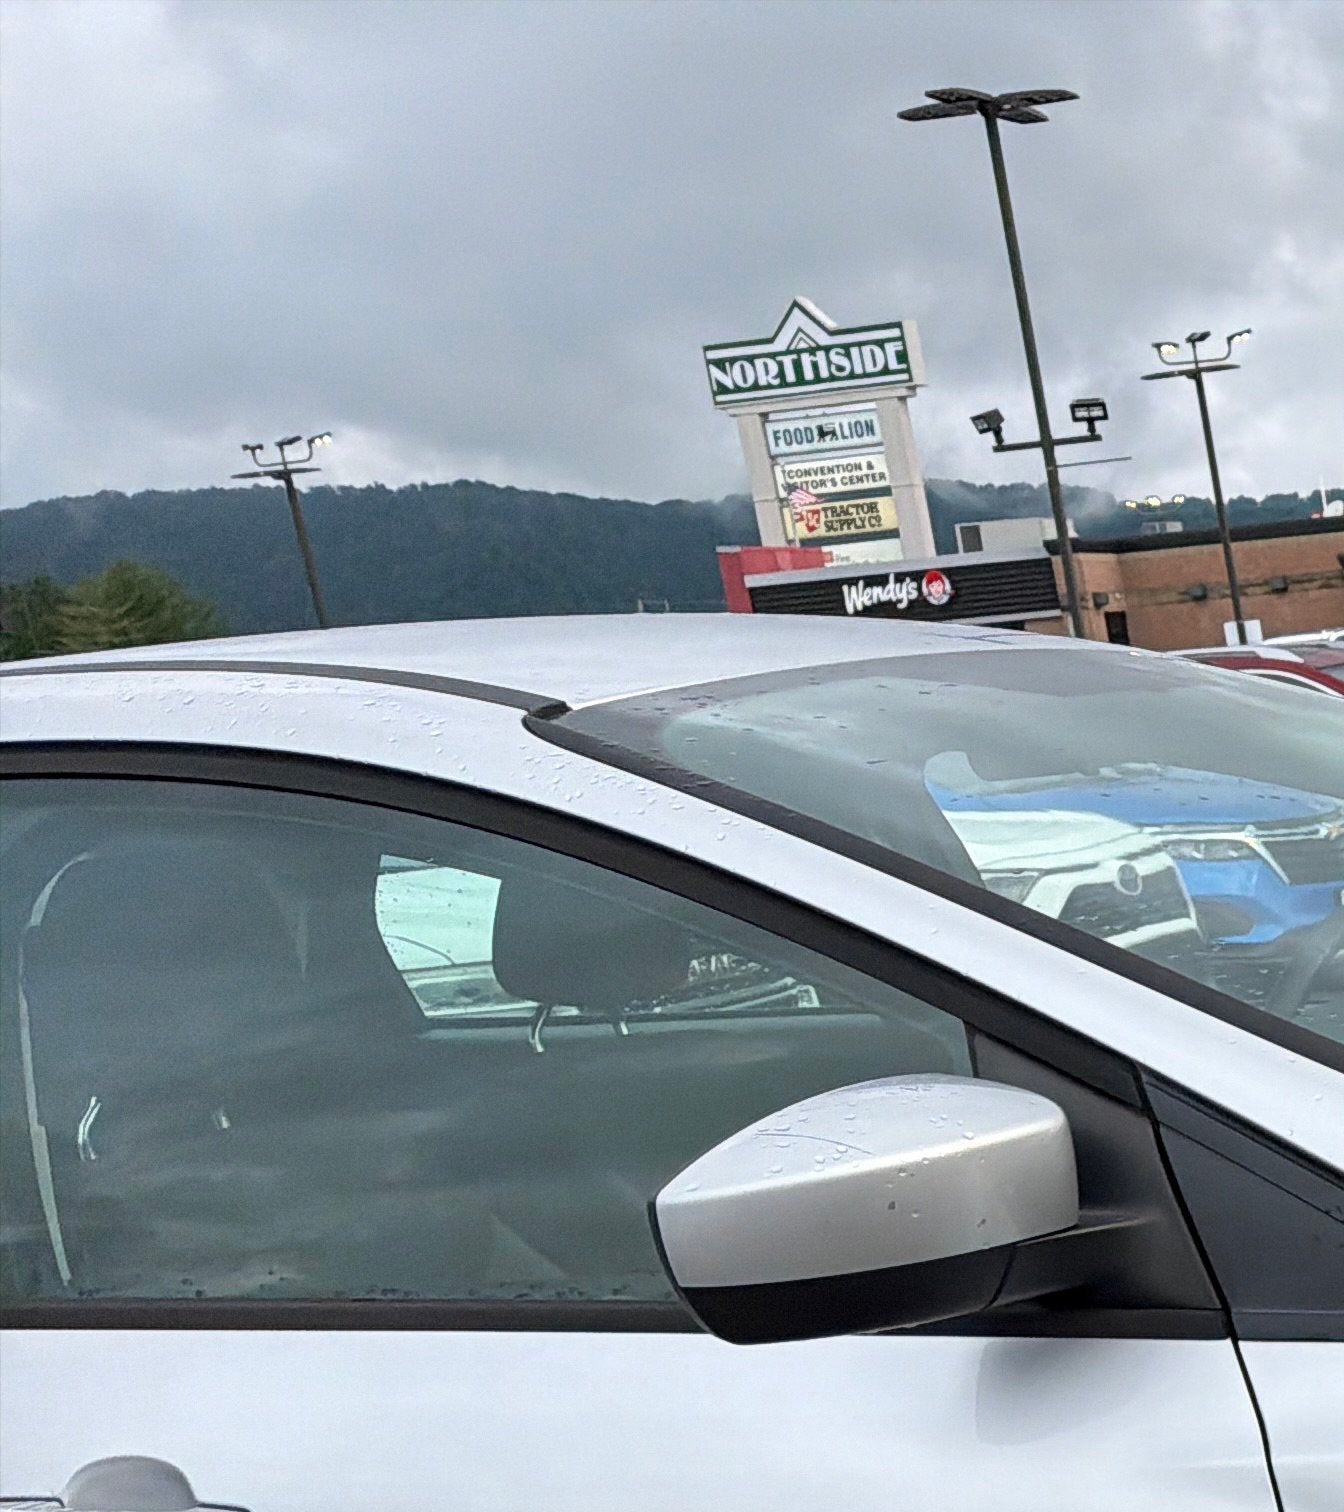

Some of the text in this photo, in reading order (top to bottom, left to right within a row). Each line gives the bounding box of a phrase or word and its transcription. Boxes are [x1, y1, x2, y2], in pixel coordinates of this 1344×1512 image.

[708, 341, 908, 391] NORTHSIDE
[772, 419, 876, 447] FOOD LION
[786, 460, 875, 479] CONVENTION &
[840, 472, 887, 486] CENTER
[821, 502, 880, 519] TRACTOR
[824, 516, 867, 532] SUPPLY
[842, 573, 919, 615] Wendy's
